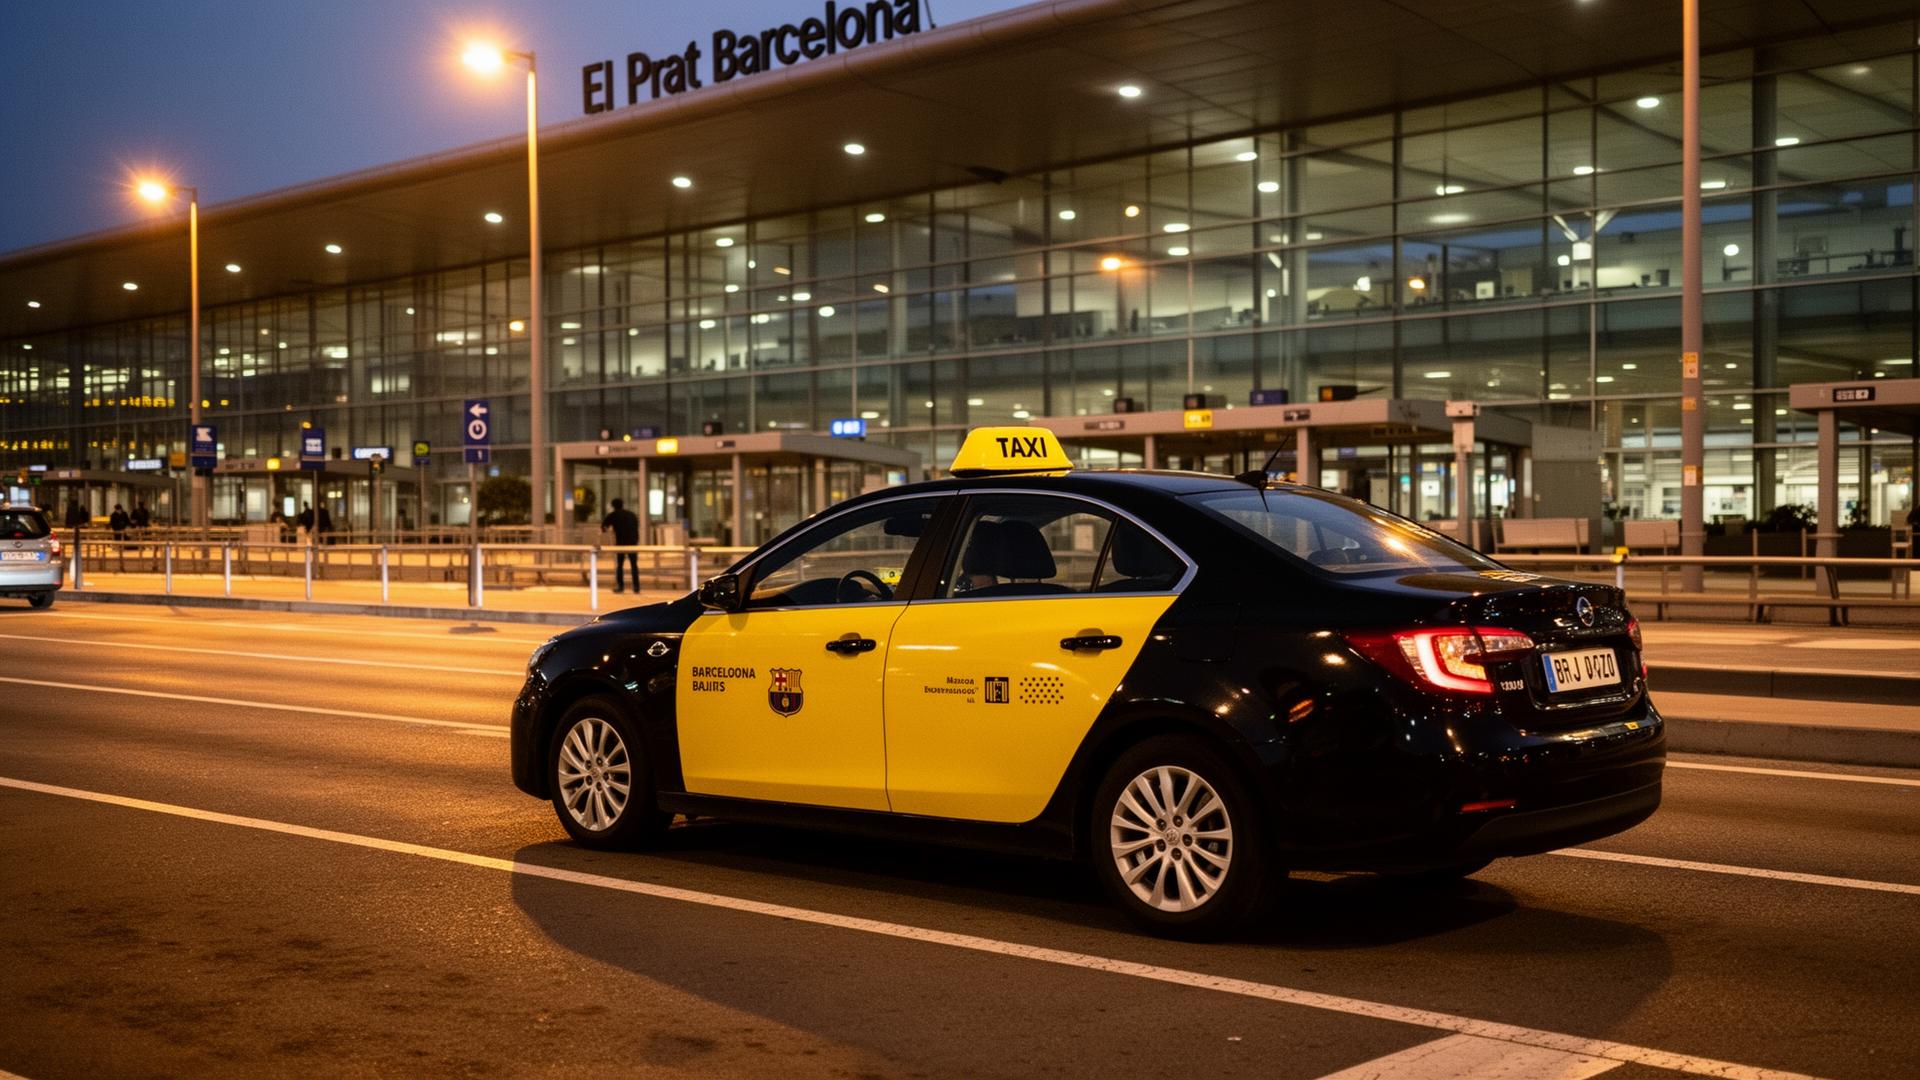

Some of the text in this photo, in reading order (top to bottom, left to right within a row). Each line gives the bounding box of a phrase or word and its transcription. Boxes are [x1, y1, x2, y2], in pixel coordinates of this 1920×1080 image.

[583, 0, 921, 114] El Prat Barcelona
[996, 437, 1048, 458] TAXI
[692, 666, 756, 679] BARCELOONA
